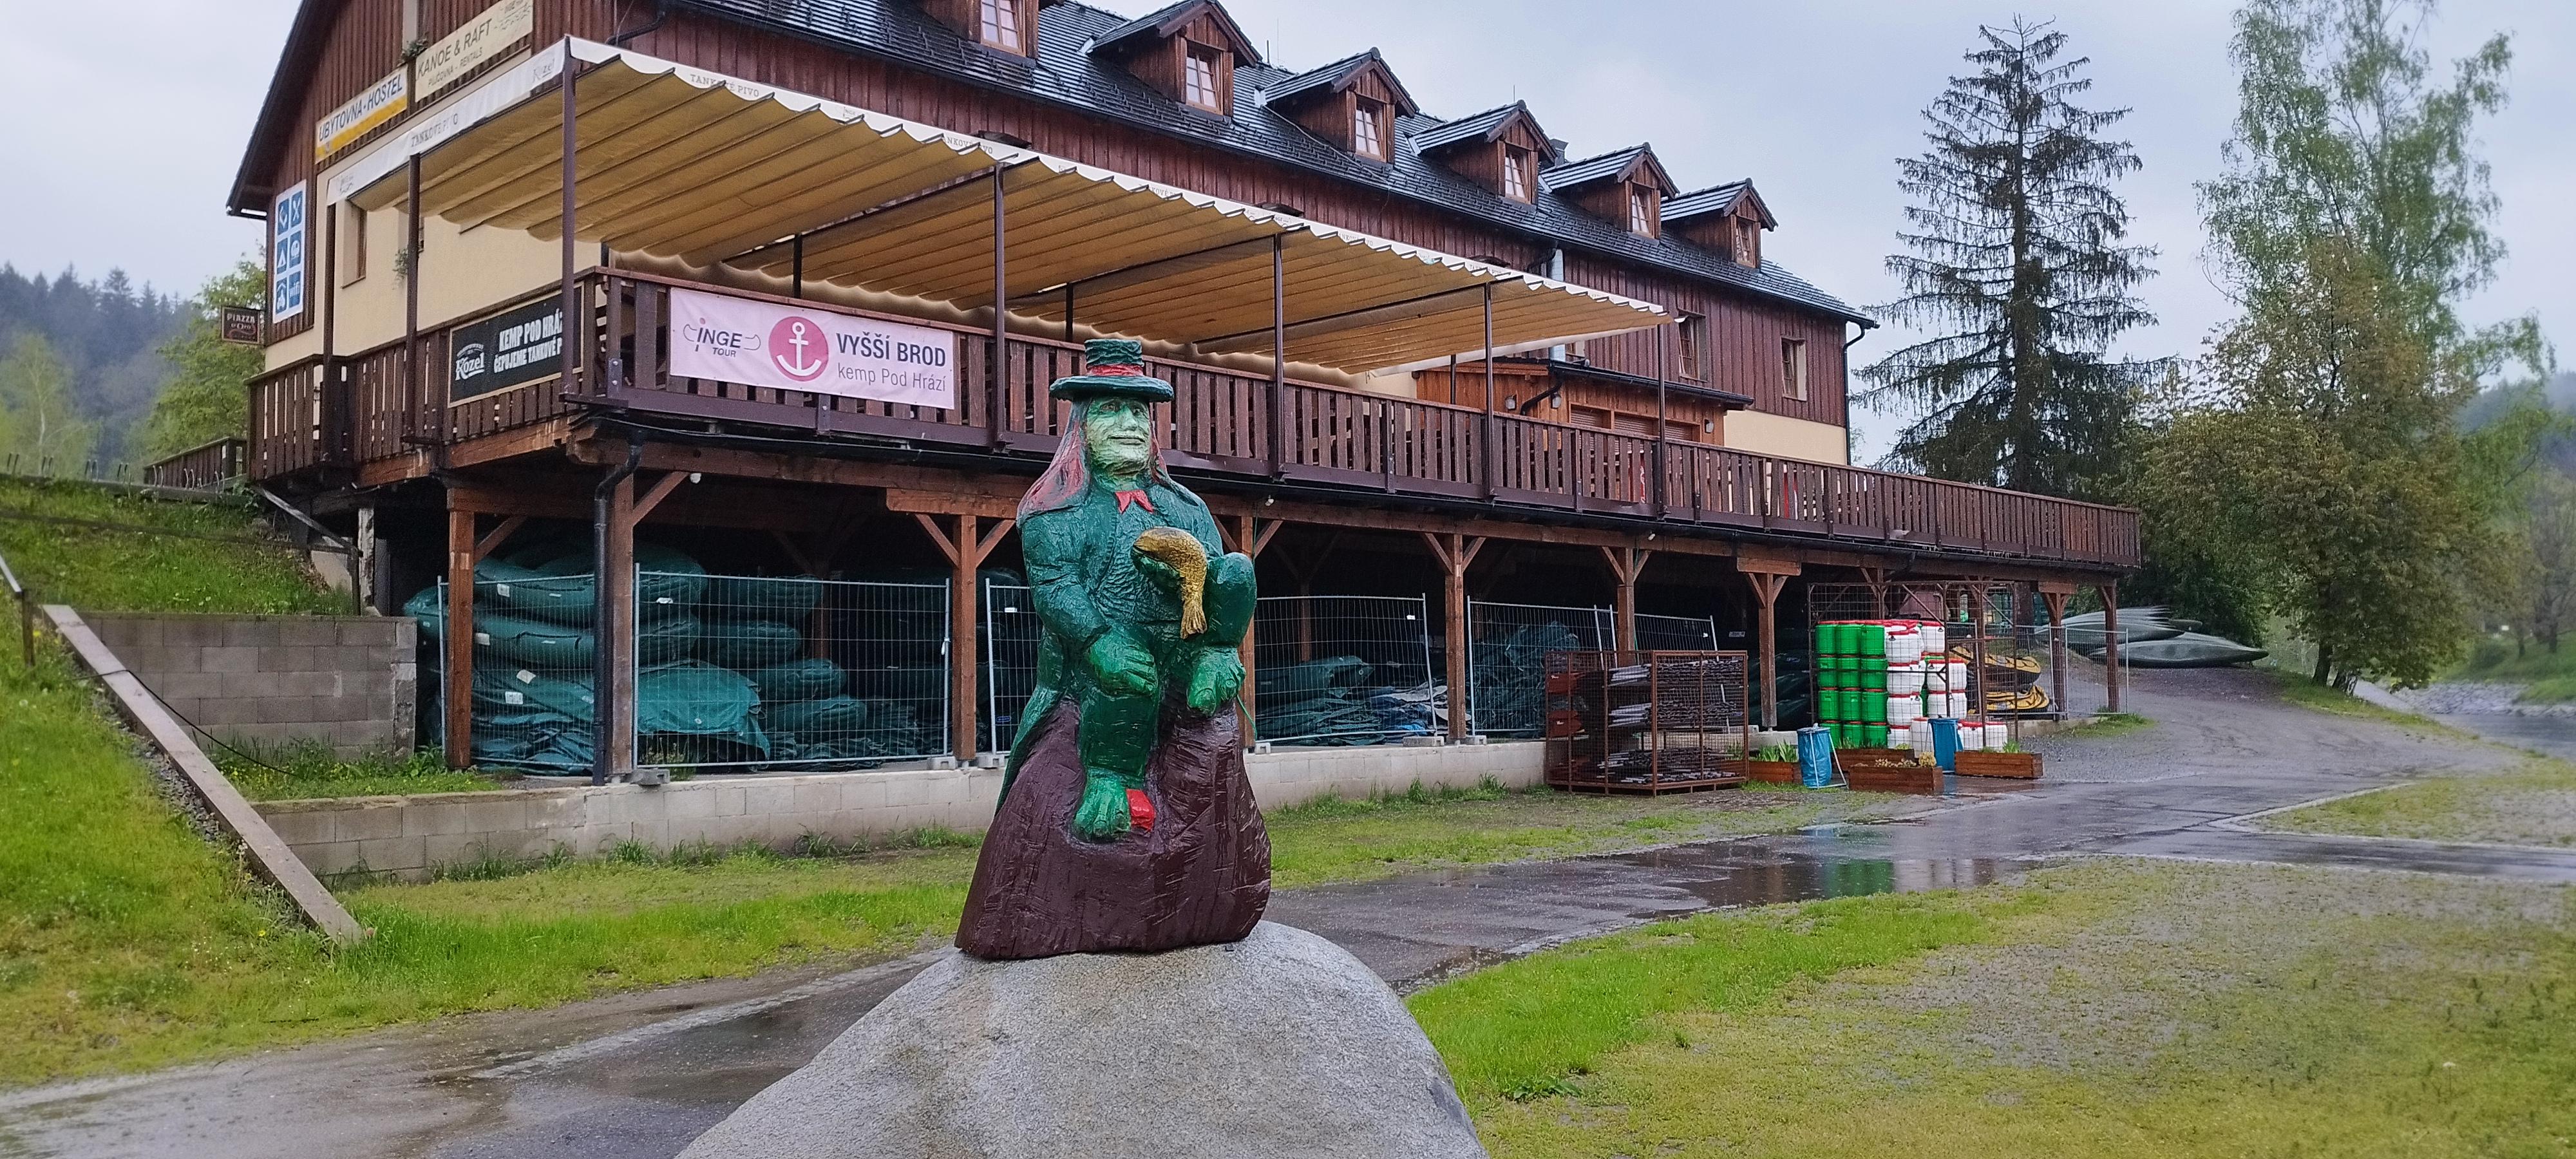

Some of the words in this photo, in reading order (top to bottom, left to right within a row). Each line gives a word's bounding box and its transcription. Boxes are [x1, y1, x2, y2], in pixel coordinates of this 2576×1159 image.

[417, 44, 451, 78] KANOE
[454, 39, 460, 56] &
[463, 19, 492, 51] RAFT
[737, 85, 759, 97] PIVO
[227, 313, 256, 324] PIAZZA
[499, 325, 524, 352] KEMP
[524, 319, 541, 344] POD
[836, 331, 891, 360] VYŠŠÍ
[897, 342, 946, 367] BROD
[455, 352, 485, 381] Kozel
[712, 347, 737, 357] TOUR
[838, 363, 876, 386] kemp
[882, 368, 907, 387] Pod
[913, 373, 947, 392] Hrází
